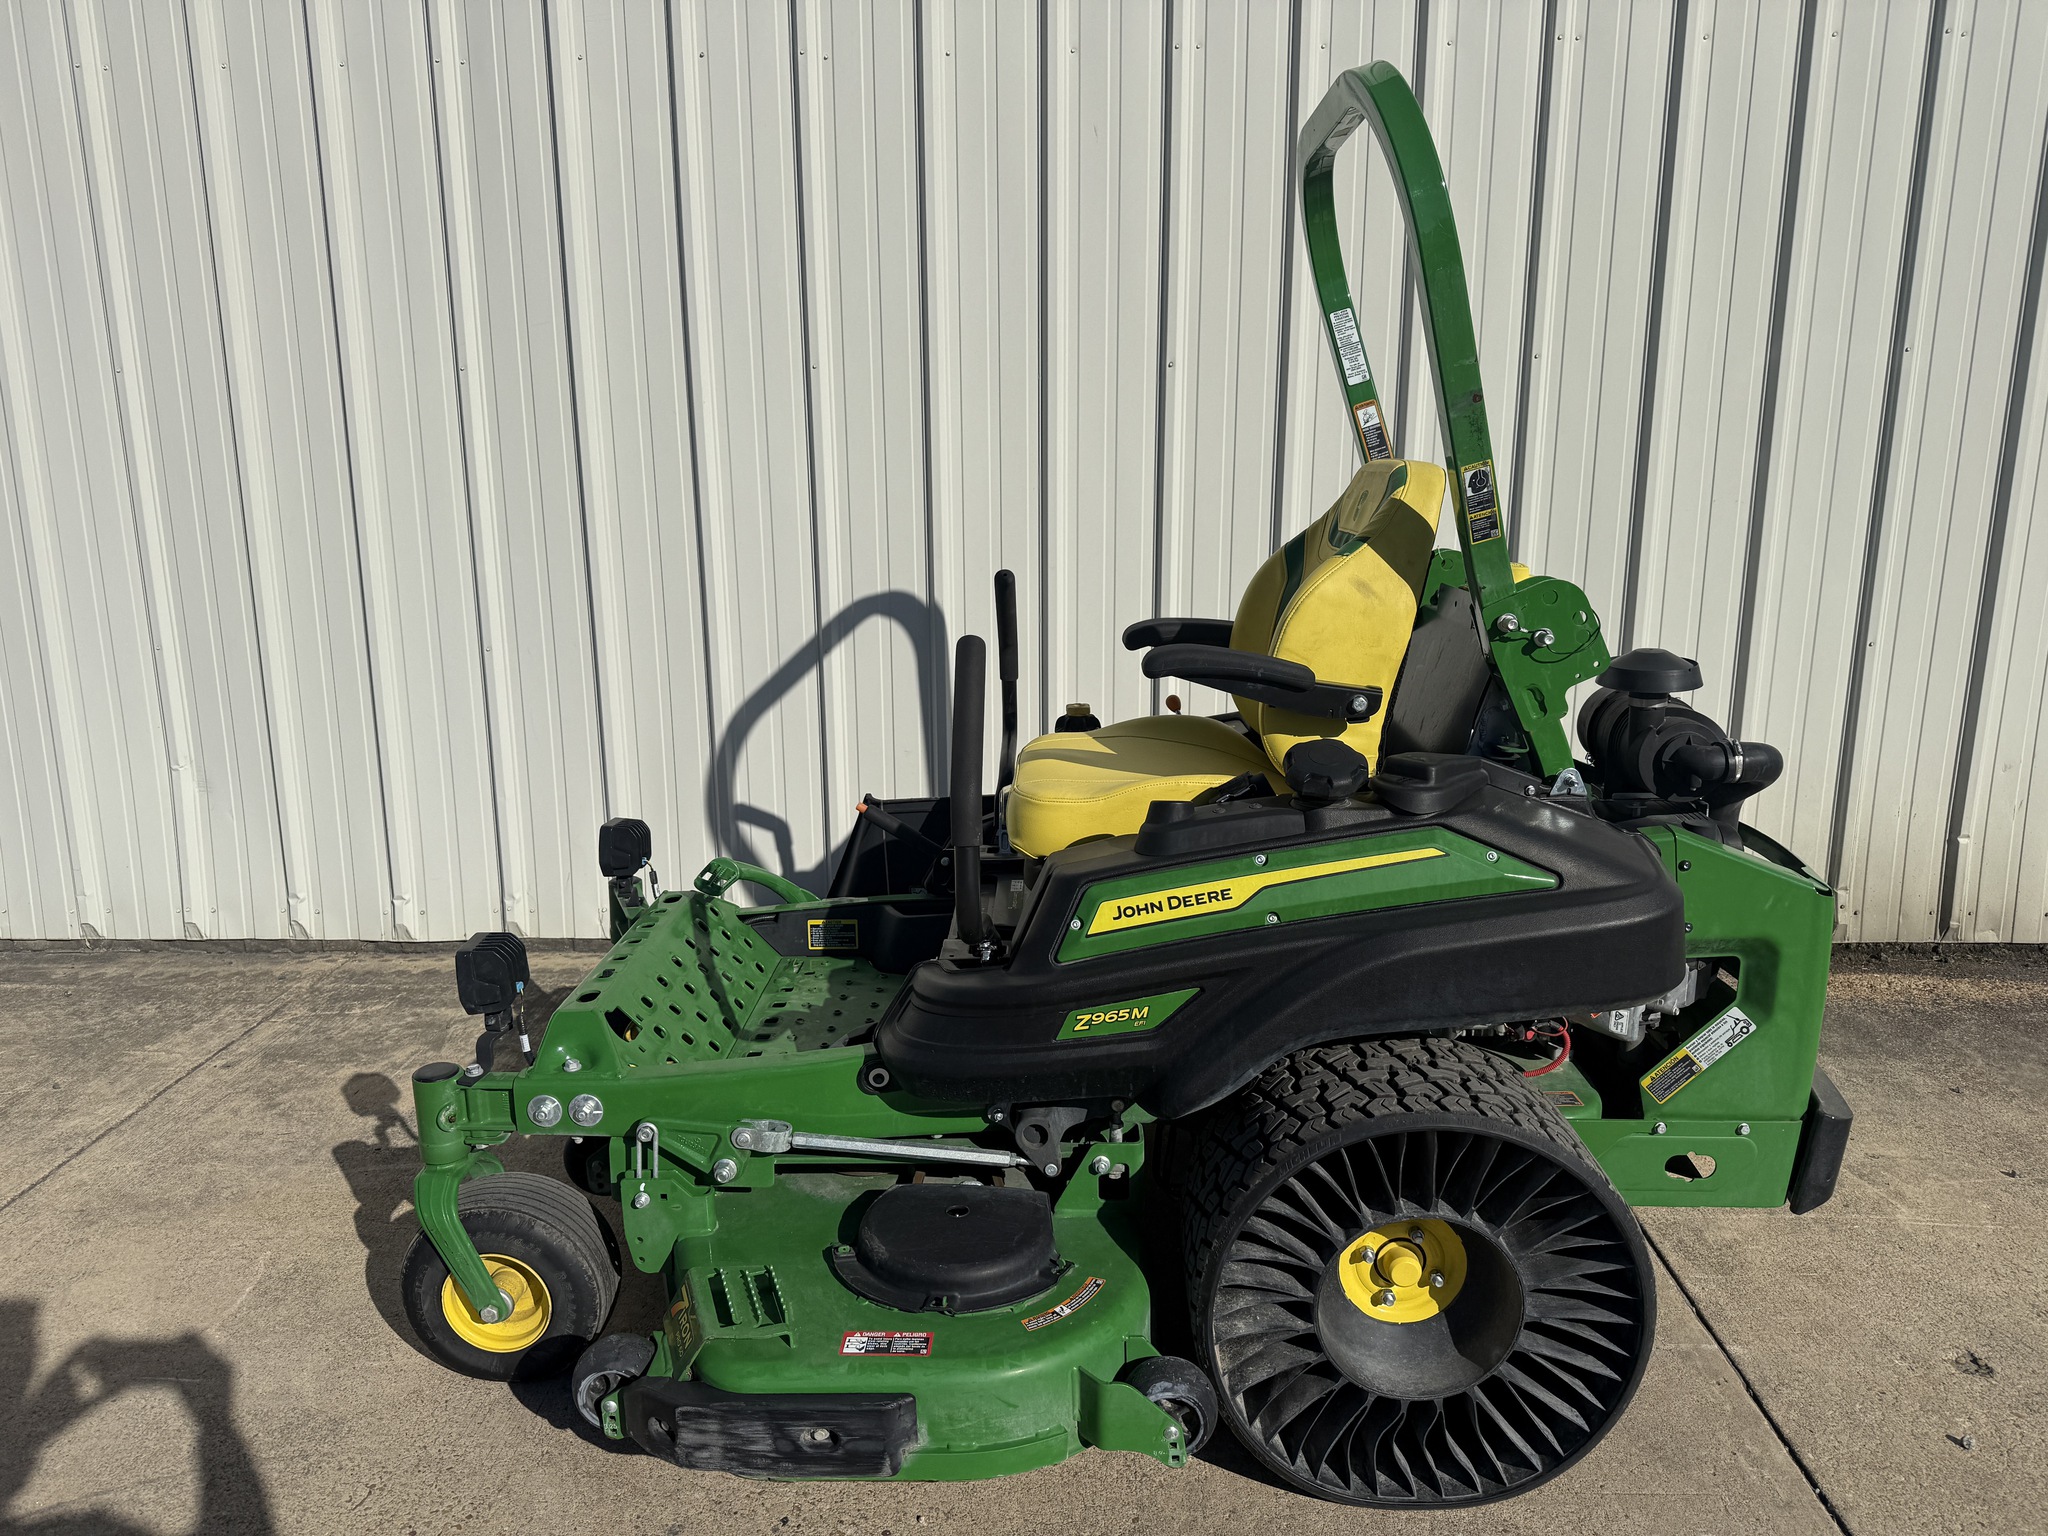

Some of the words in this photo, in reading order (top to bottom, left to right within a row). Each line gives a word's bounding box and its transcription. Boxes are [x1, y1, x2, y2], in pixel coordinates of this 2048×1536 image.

[1112, 900, 1163, 921] JOHN
[1167, 888, 1233, 911] DEERE
[1073, 1006, 1150, 1031] Z965M
[1654, 1055, 1680, 1076] ATENCIÓN
